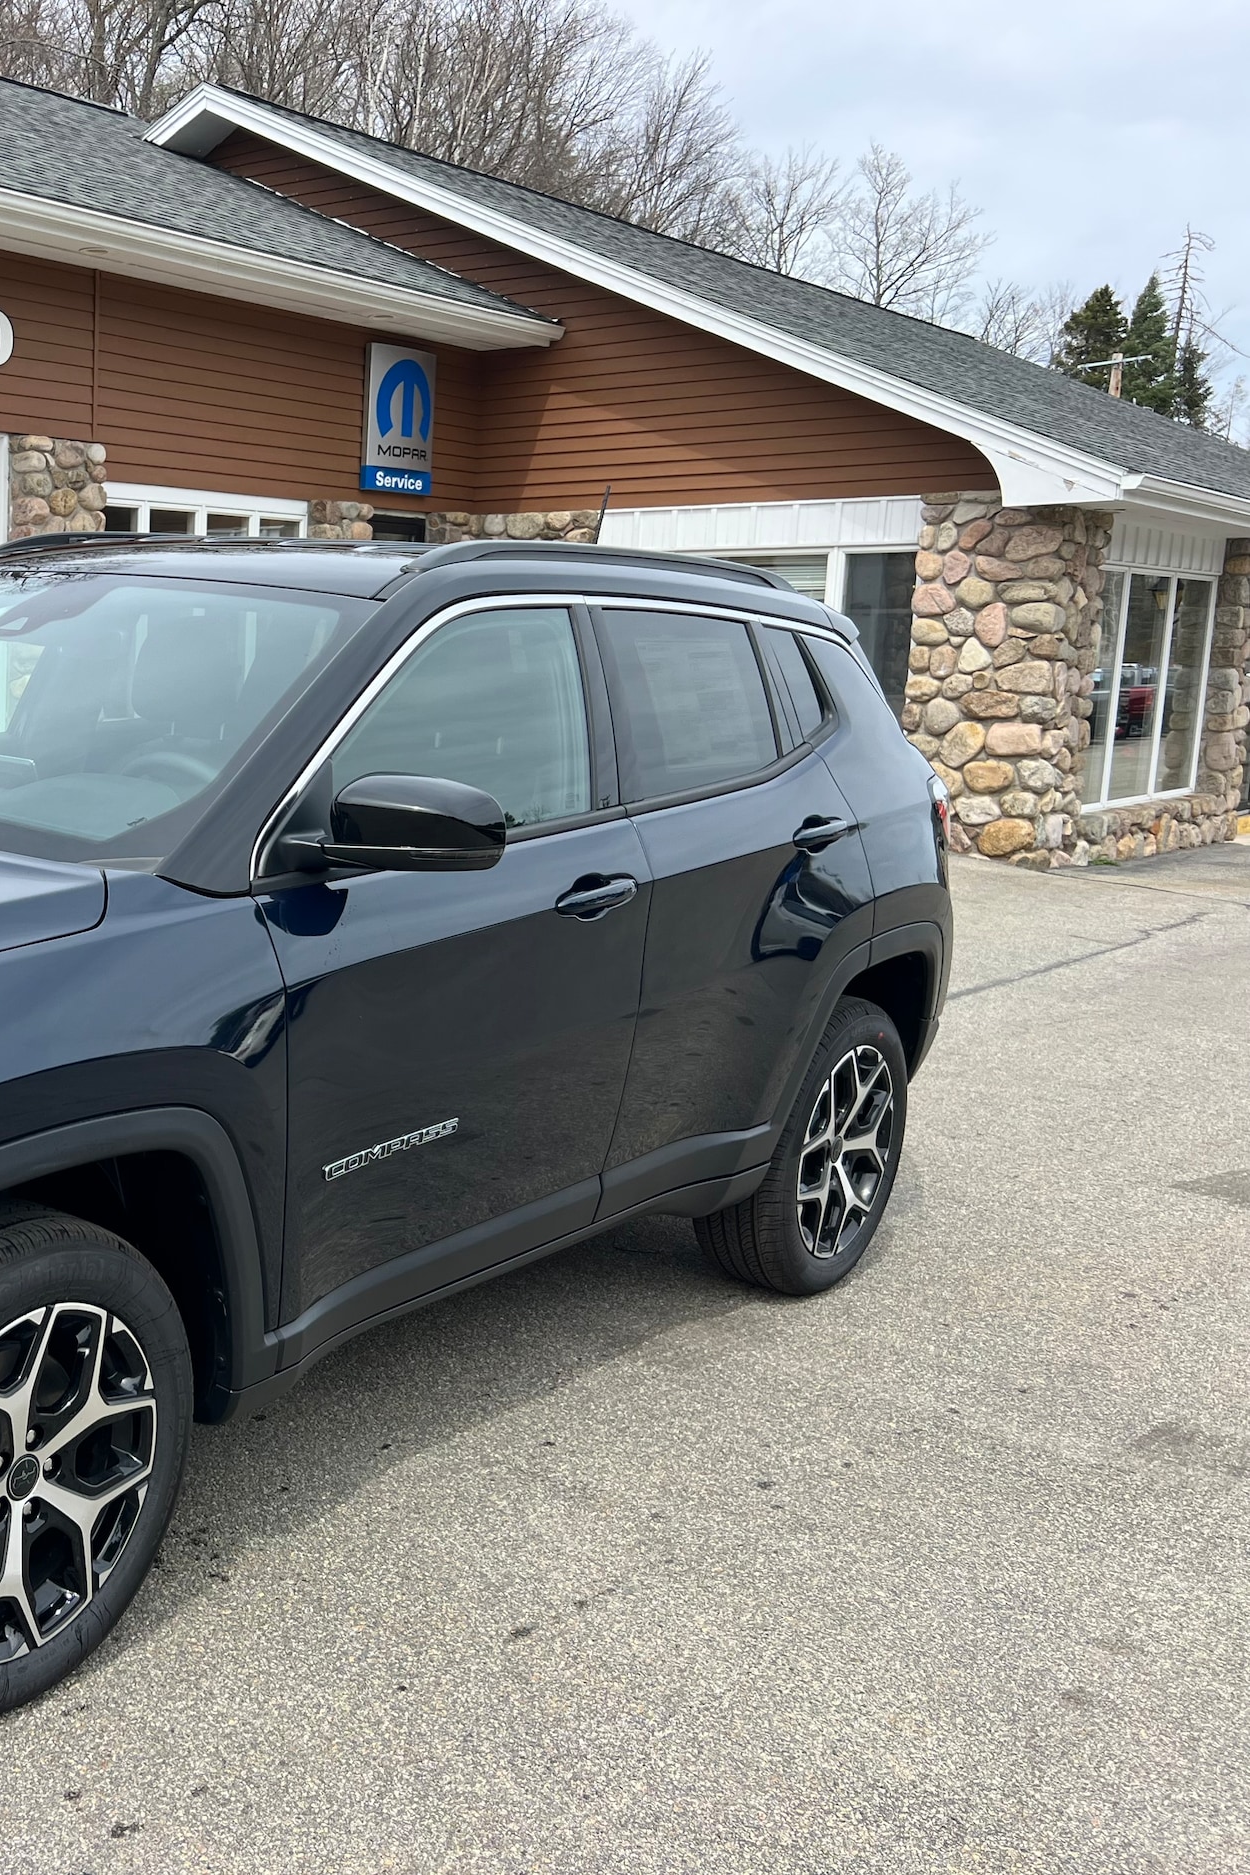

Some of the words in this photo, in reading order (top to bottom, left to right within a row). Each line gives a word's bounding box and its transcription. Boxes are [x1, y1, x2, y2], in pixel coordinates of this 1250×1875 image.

[377, 444, 427, 461] MOPAR
[375, 471, 423, 491] Service
[323, 1117, 459, 1182] COMPASS
